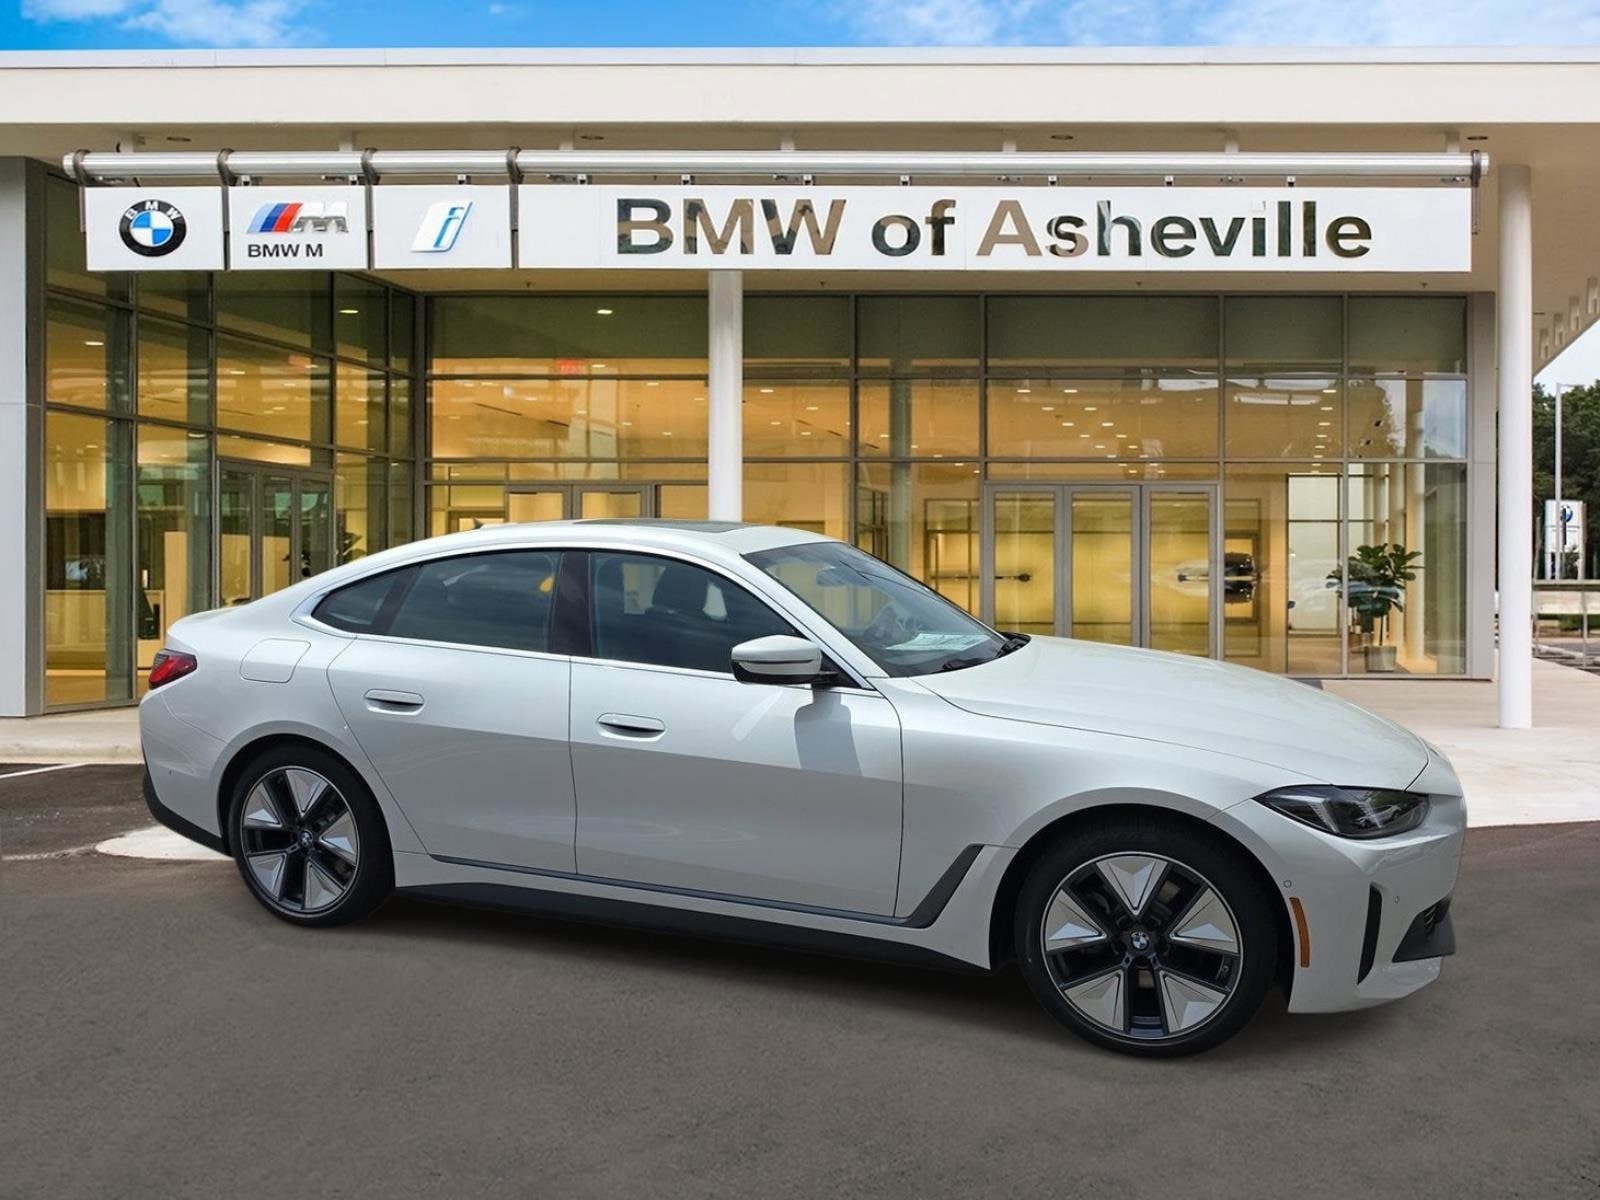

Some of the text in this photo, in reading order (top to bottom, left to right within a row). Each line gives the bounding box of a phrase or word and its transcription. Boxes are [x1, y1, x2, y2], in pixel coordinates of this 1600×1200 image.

[125, 201, 181, 220] BMW
[616, 198, 1372, 258] BMW of Asheville
[247, 243, 323, 257] BMW M
